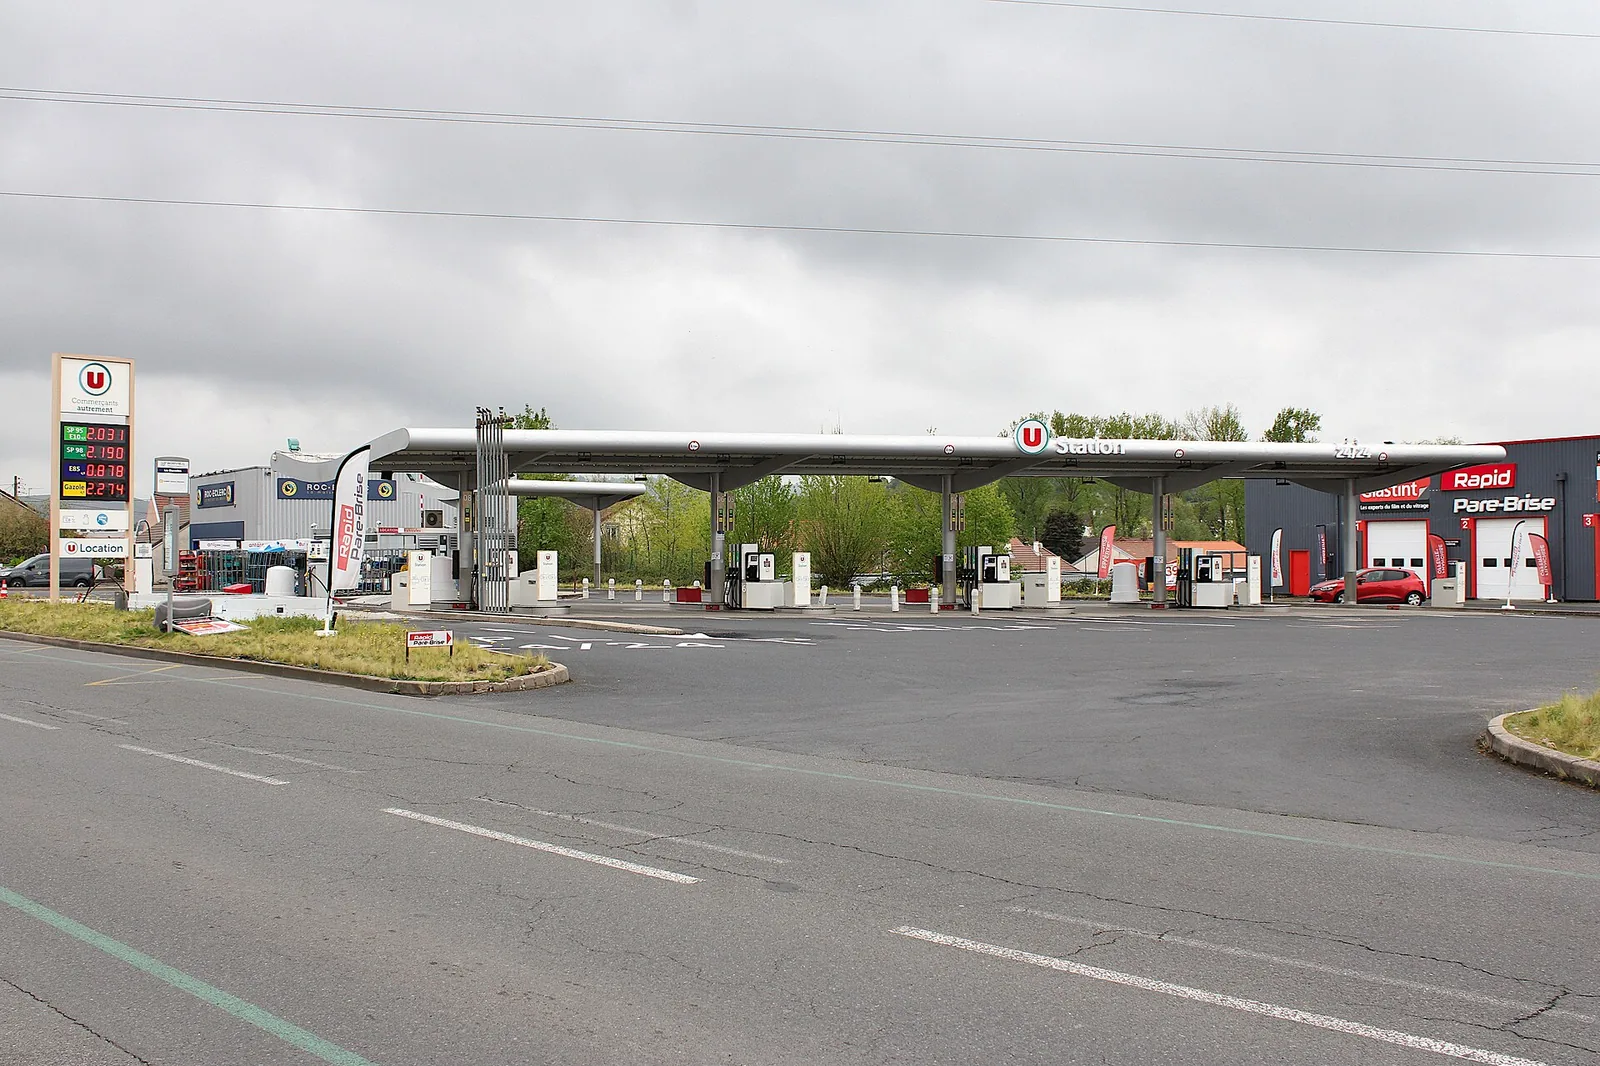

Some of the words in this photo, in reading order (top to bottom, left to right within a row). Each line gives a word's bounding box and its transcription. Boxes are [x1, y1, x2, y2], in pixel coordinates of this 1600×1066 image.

[87, 372, 104, 389] U
[72, 397, 118, 407] Commerçants
[77, 405, 113, 413] autrement
[87, 427, 124, 441] 2.031
[1023, 428, 1041, 447] U
[86, 445, 124, 459] 2.190
[1056, 436, 1126, 455] Station
[86, 464, 124, 478] 0.878
[1453, 469, 1511, 489] Rapid
[86, 482, 124, 496] 2.274
[1453, 493, 1556, 513] Pare-Brise
[350, 473, 364, 560] Pare-Brise
[1585, 517, 1592, 526] 3
[1462, 520, 1468, 529] 2
[340, 508, 353, 558] Rapid
[80, 543, 124, 553] Location
